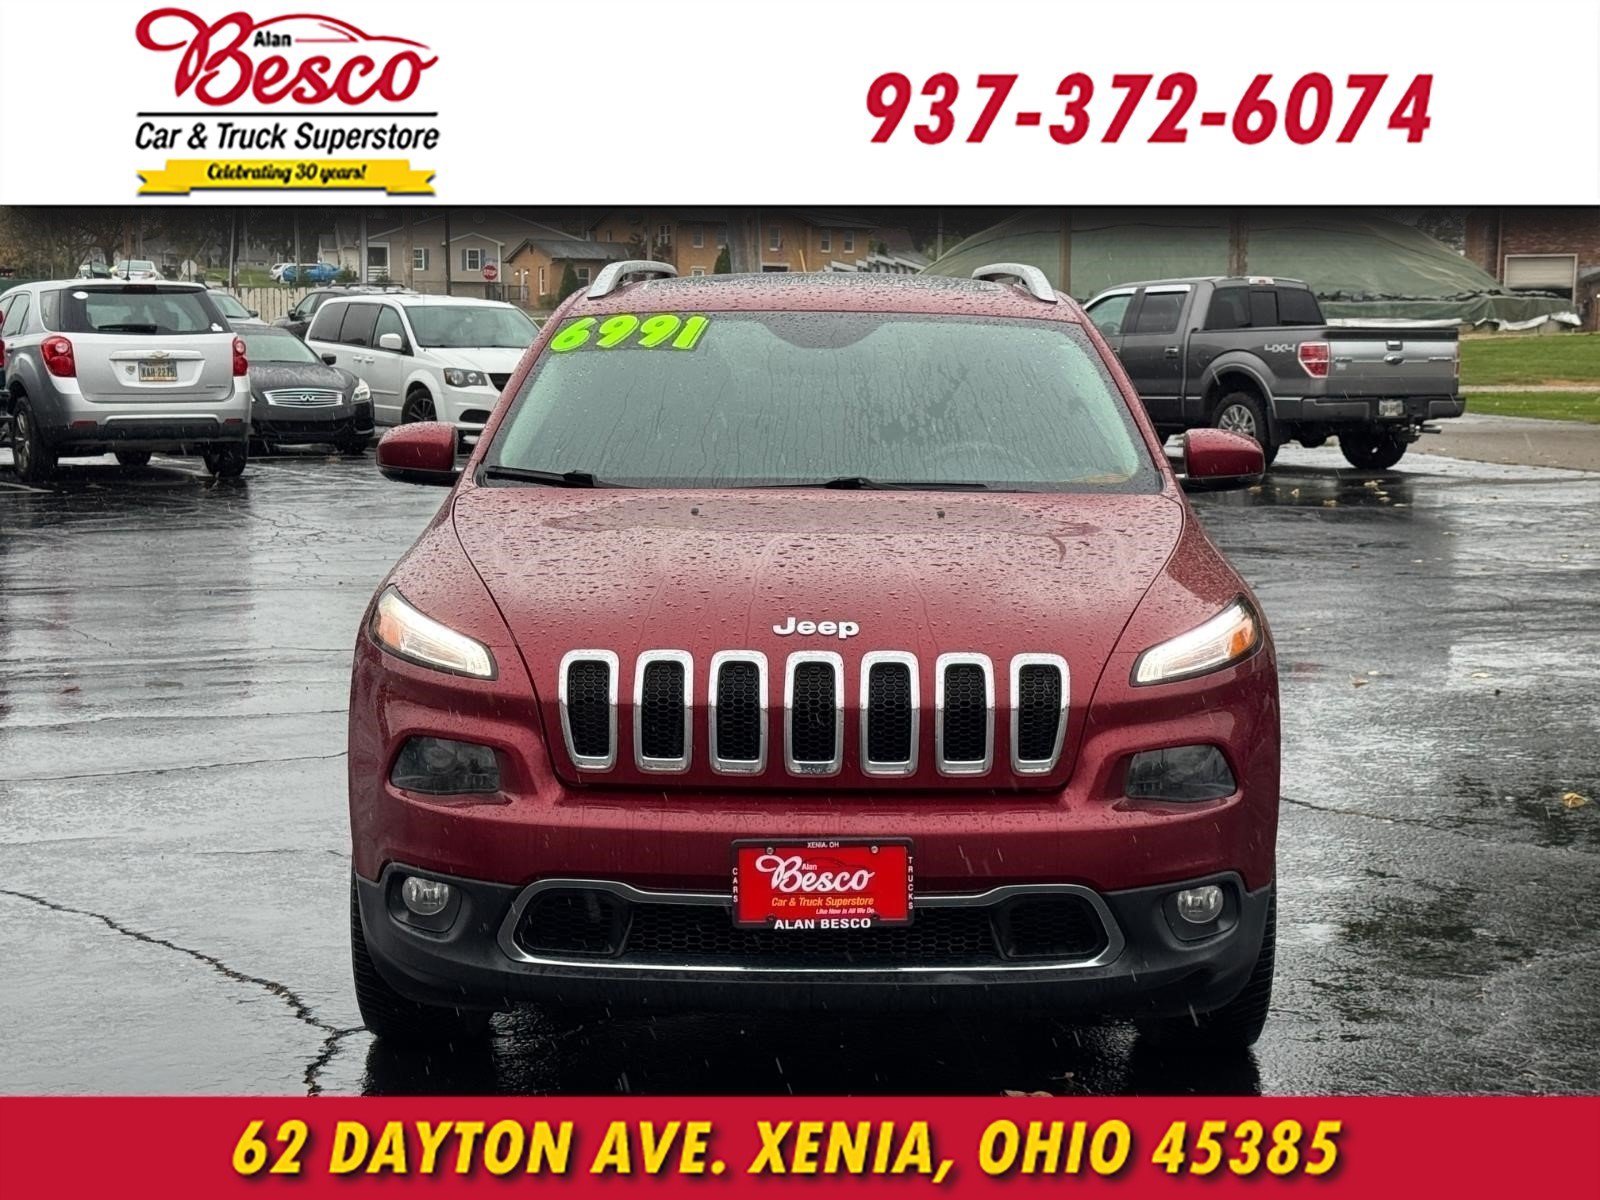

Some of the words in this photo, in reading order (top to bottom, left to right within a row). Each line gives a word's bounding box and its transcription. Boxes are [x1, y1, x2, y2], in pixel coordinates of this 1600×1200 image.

[550, 314, 710, 352] 6991
[772, 617, 860, 639] Jeep
[755, 854, 876, 893] Besco
[801, 863, 818, 871] Alan
[771, 897, 788, 907] Car
[788, 898, 797, 907] &
[799, 896, 823, 907] Truck
[825, 896, 874, 908] Superstore
[774, 918, 815, 930] ALAN
[820, 917, 871, 929] BESCO
